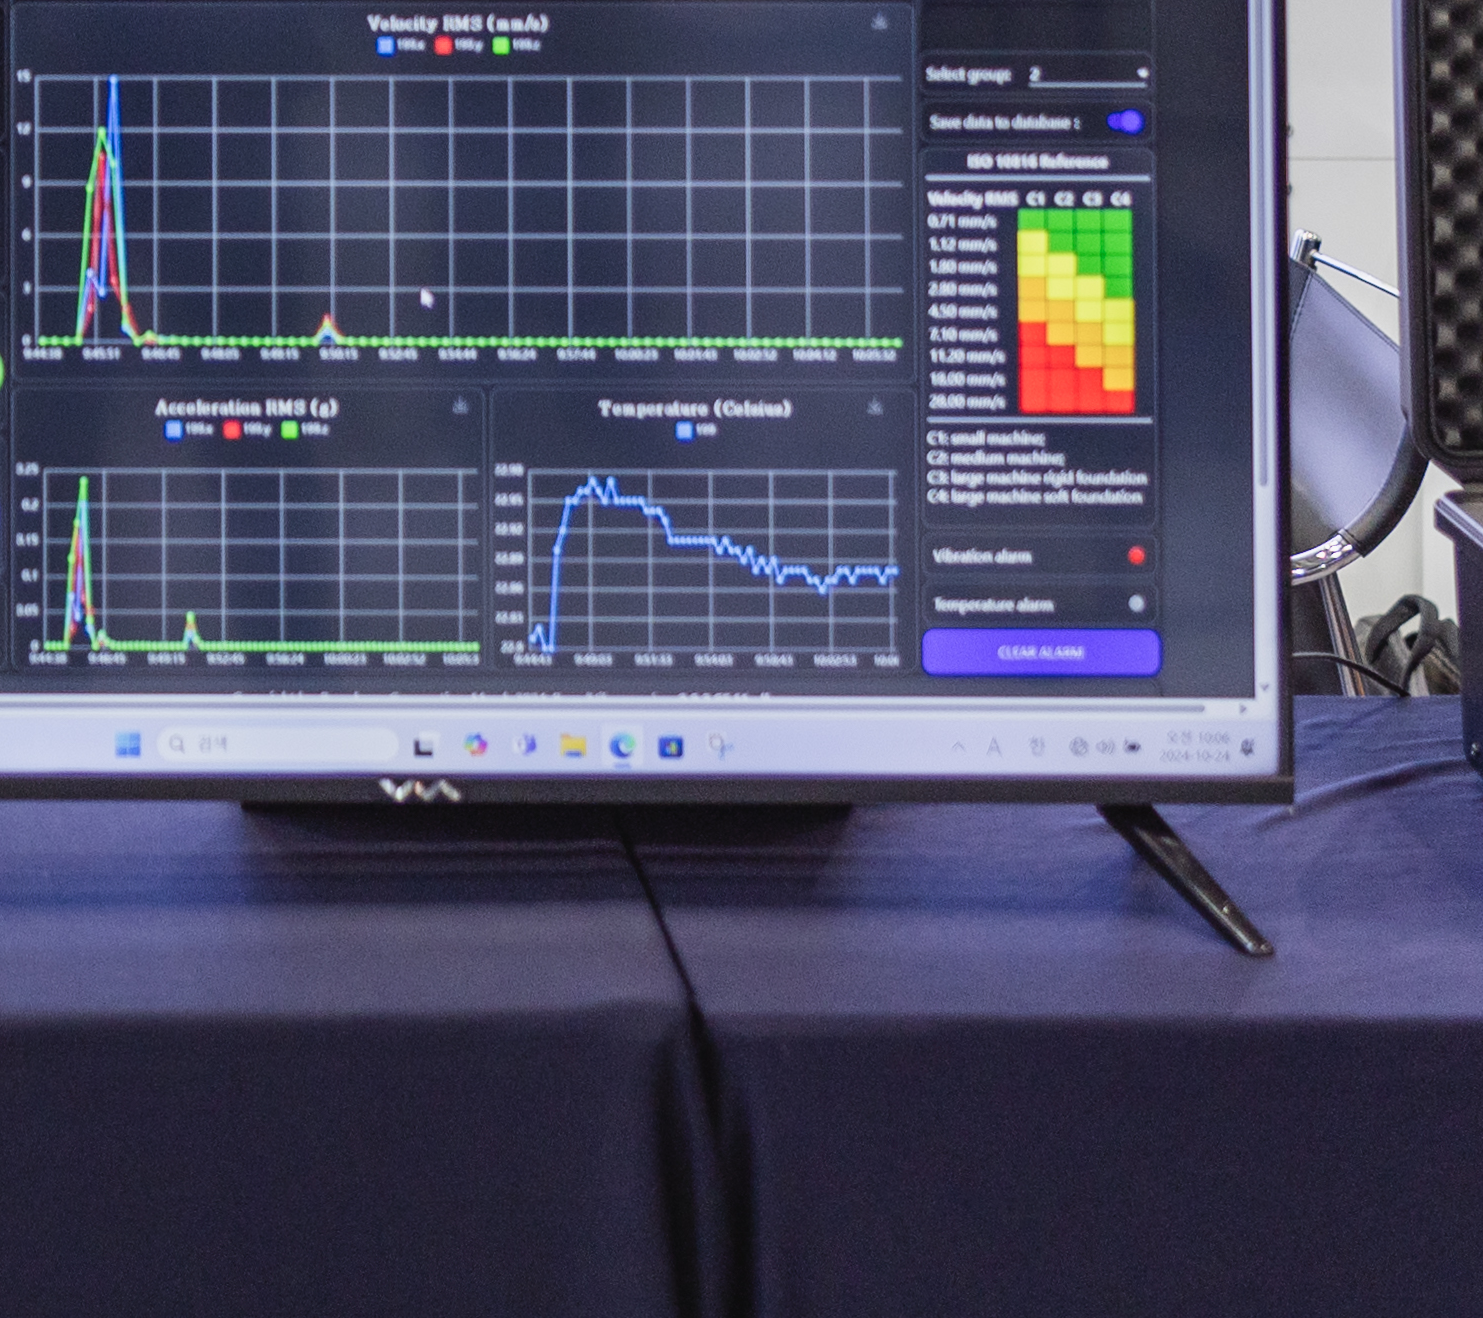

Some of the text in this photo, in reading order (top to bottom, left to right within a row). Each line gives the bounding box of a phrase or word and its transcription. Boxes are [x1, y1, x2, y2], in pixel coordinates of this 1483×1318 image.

[366, 14, 437, 33] Velocity
[154, 398, 261, 417] Acceleration
[597, 398, 710, 420] Temperature
